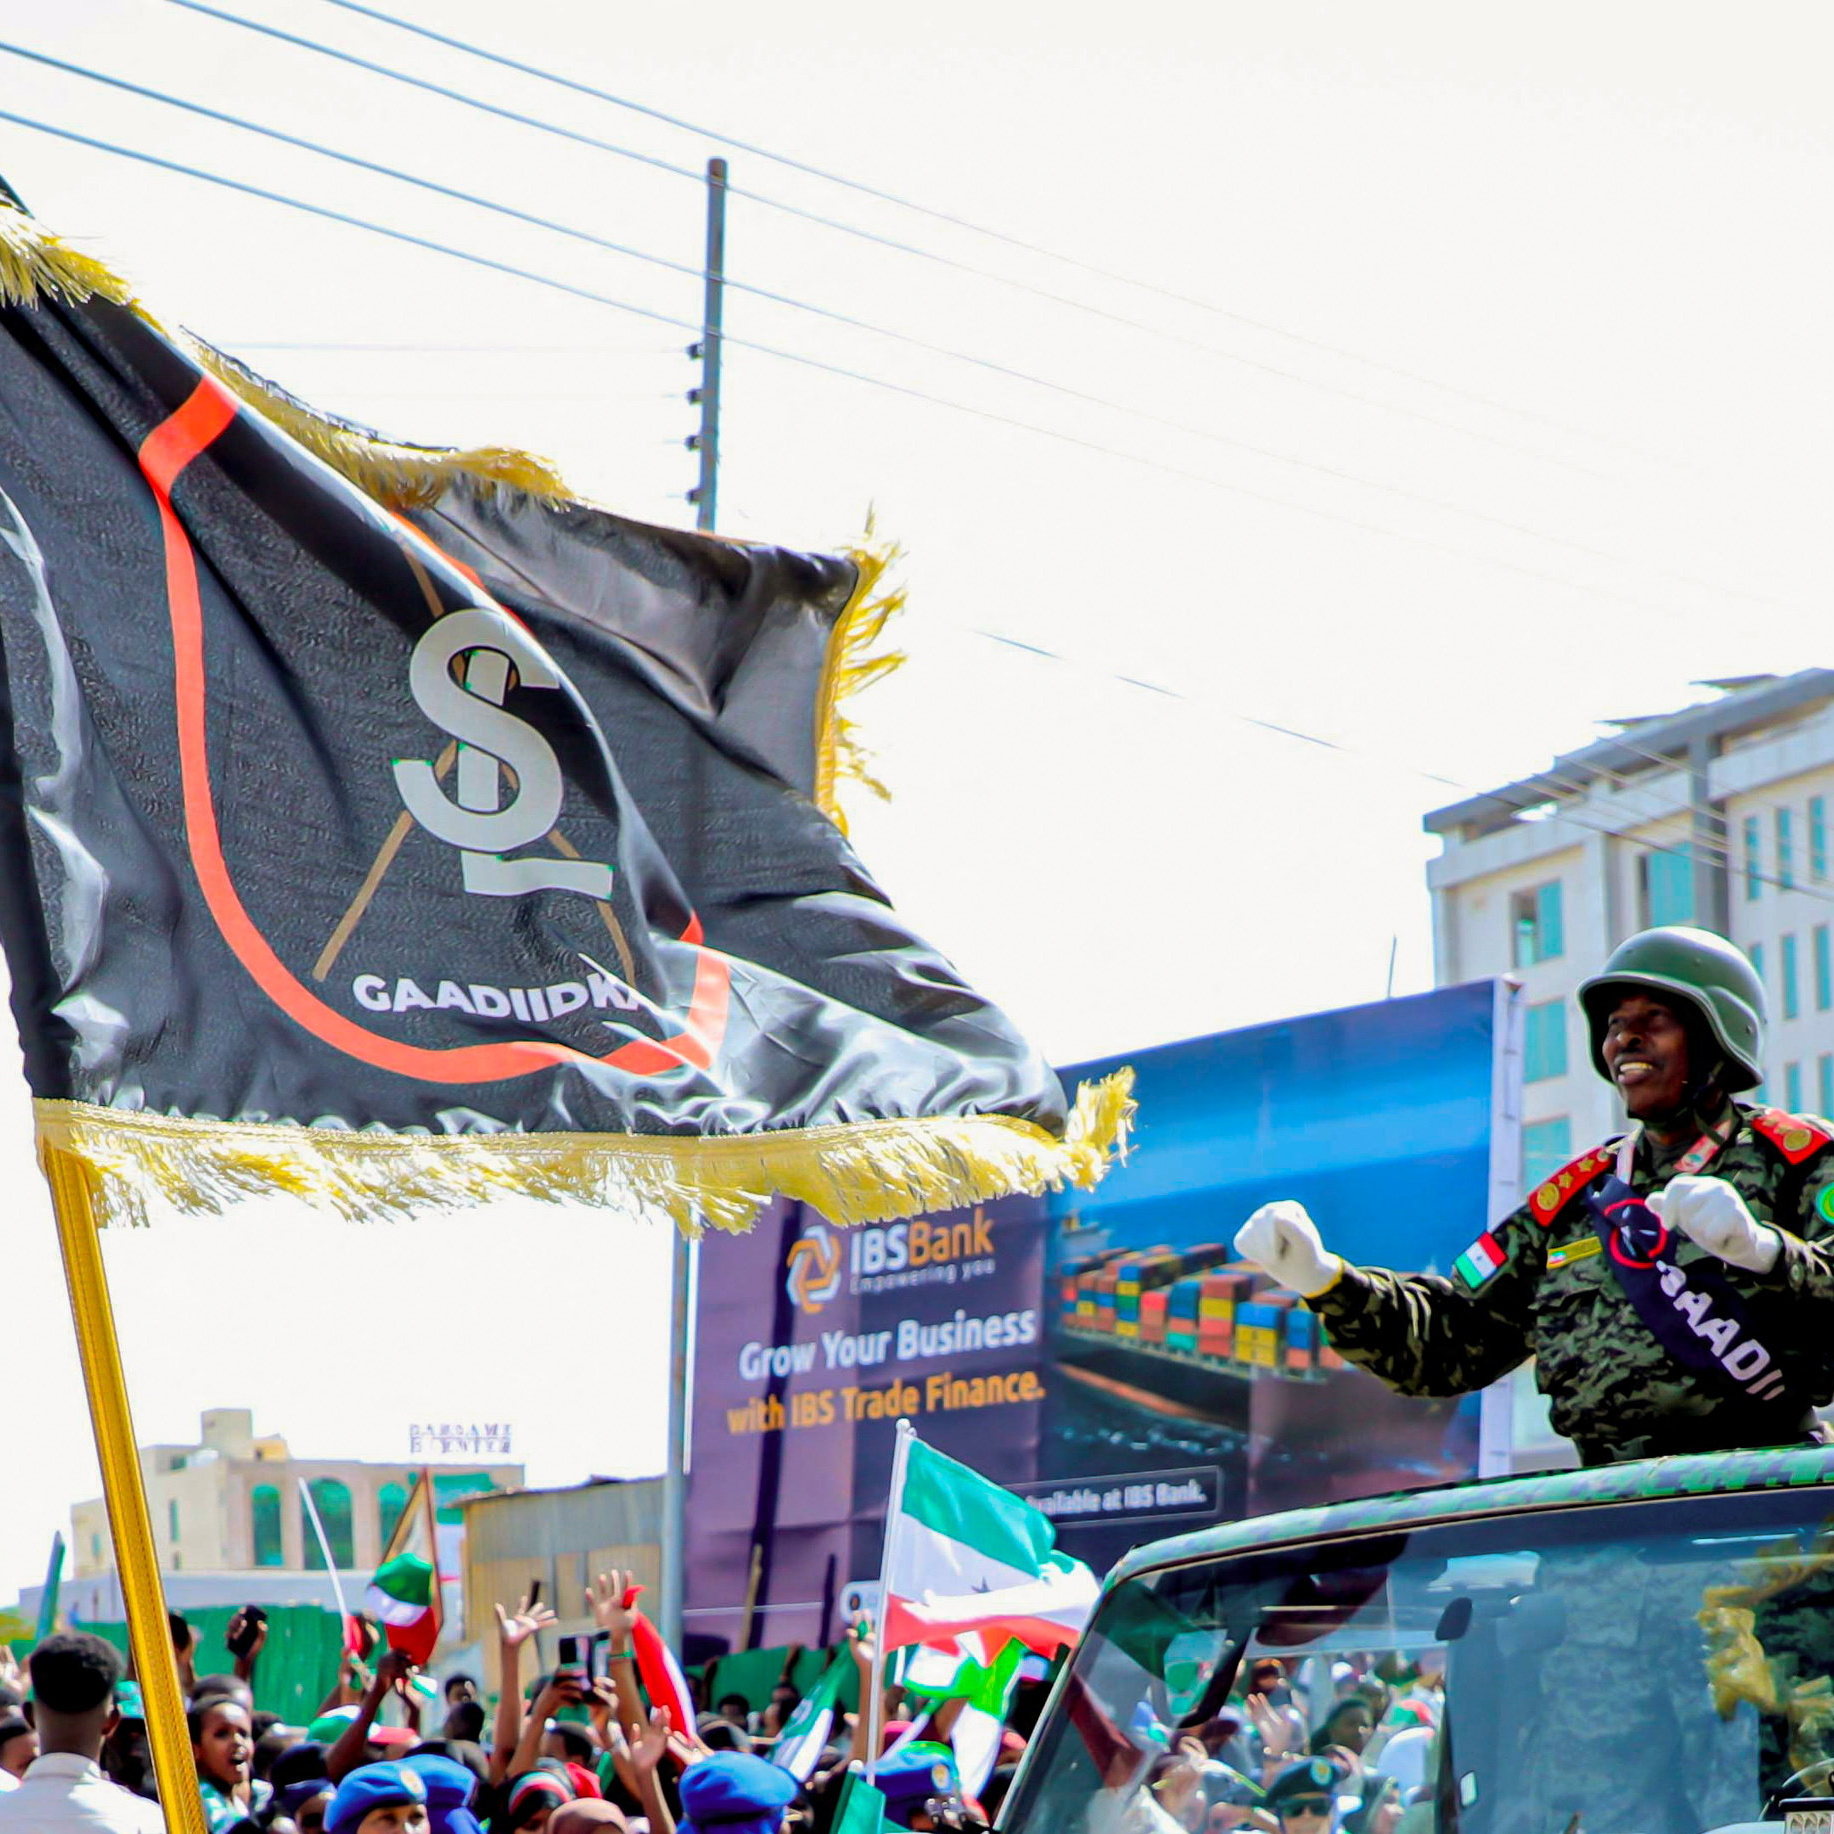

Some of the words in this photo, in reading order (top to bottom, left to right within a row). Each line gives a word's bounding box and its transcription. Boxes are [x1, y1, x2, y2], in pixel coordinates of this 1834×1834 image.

[962, 1257, 996, 1282] you
[739, 1340, 817, 1381] Grow
[821, 1329, 893, 1370] Your
[896, 1308, 1037, 1361] Business
[727, 1393, 786, 1436] with
[791, 1389, 835, 1427] IBS
[840, 1377, 920, 1421] Trade
[925, 1370, 1048, 1413] Finance.
[1102, 1487, 1123, 1511] at
[1123, 1484, 1155, 1509] IBS
